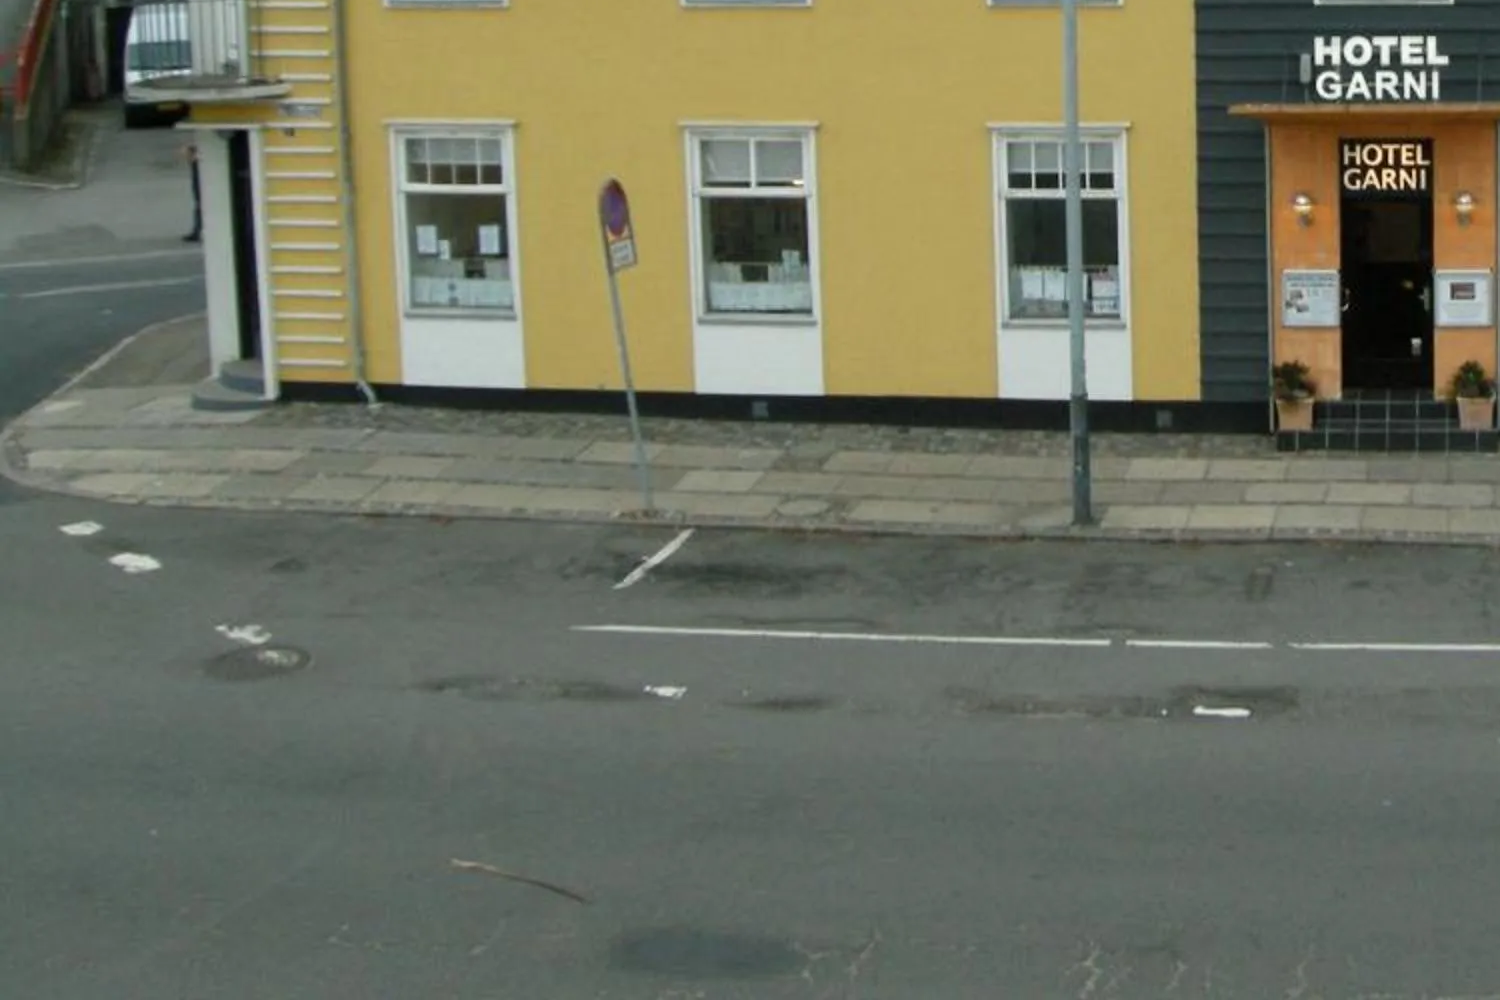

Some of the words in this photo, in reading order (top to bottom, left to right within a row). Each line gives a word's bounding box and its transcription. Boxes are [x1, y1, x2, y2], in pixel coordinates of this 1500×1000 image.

[1313, 35, 1450, 67] HOTEL
[1315, 69, 1440, 100] GARNI
[1343, 143, 1431, 166] HOTEL
[1343, 167, 1427, 191] GARNI
